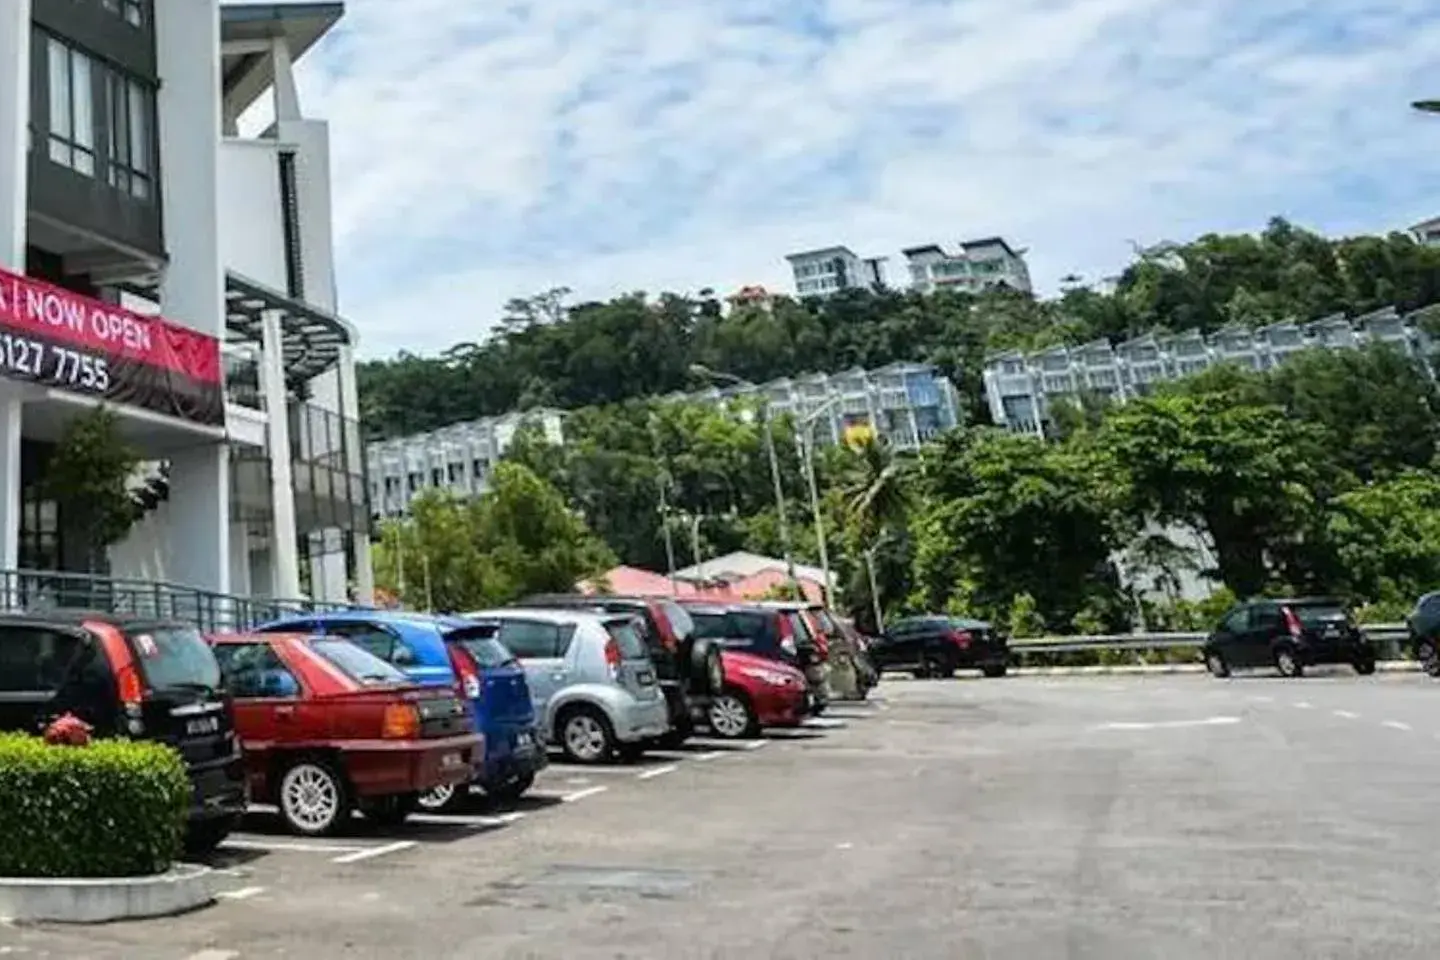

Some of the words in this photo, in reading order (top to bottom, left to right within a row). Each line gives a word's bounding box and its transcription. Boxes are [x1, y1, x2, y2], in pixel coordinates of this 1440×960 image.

[26, 289, 86, 333] NOW
[91, 309, 152, 351] OPEN
[52, 345, 109, 391] 7755
